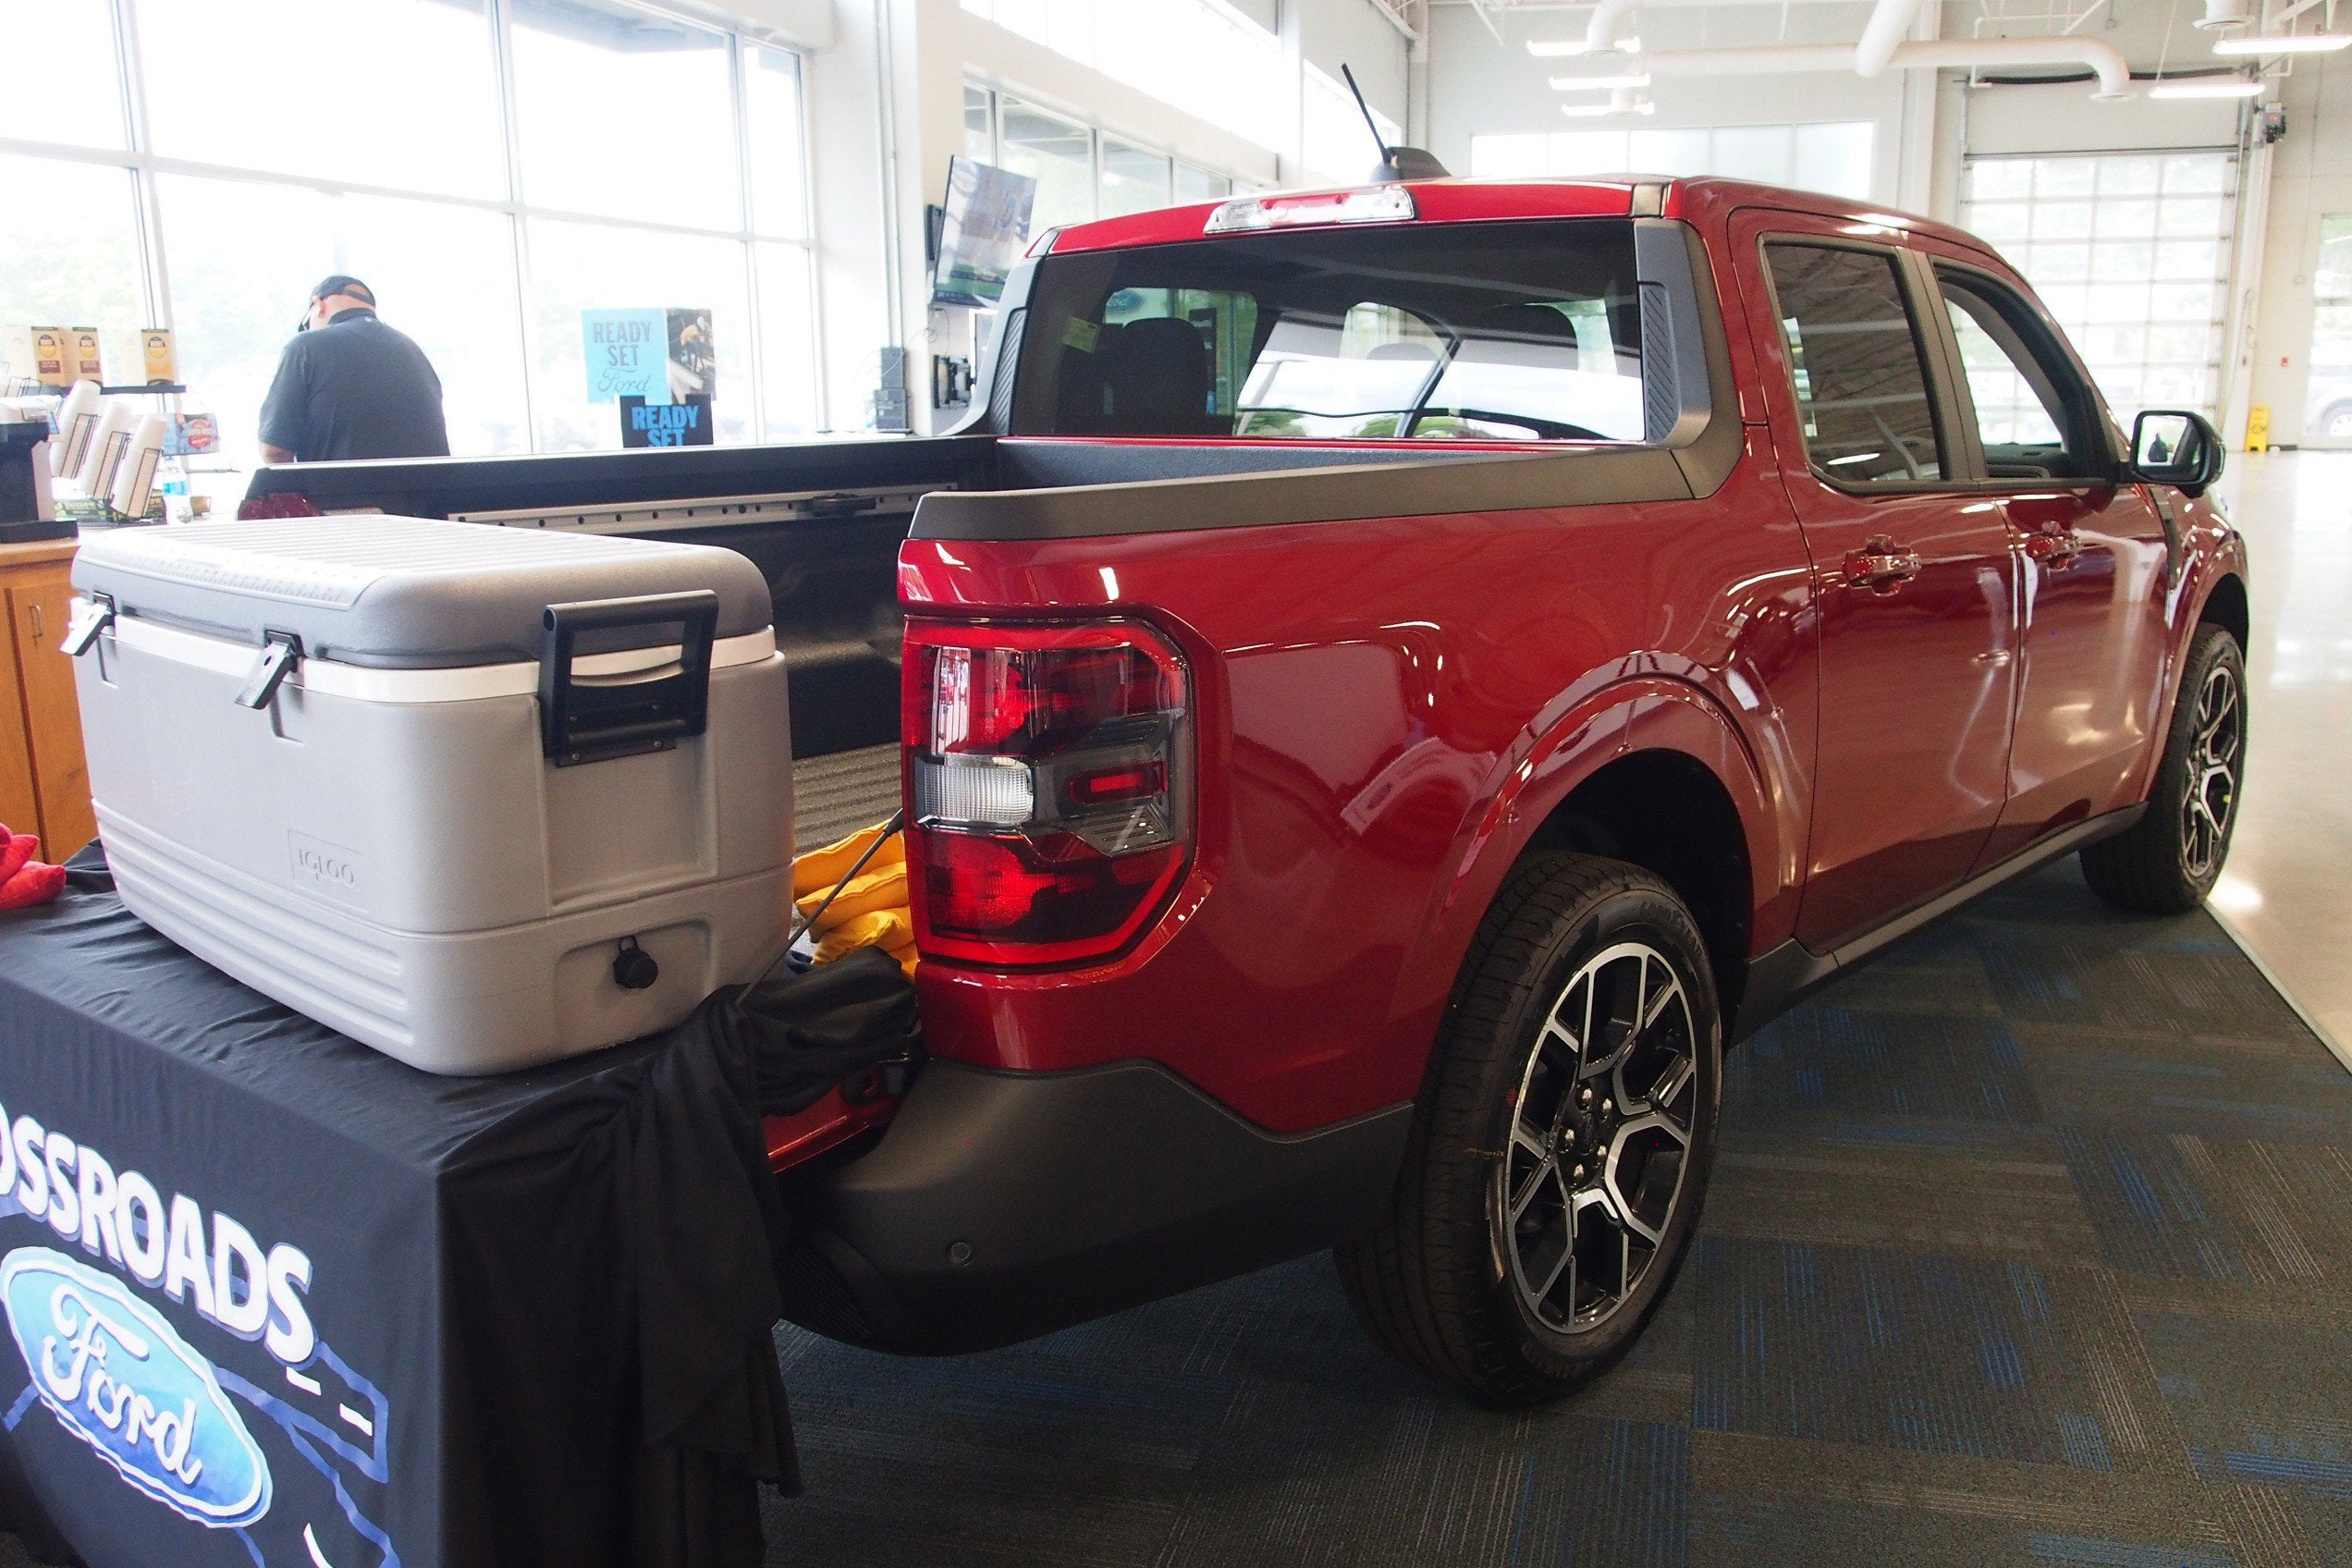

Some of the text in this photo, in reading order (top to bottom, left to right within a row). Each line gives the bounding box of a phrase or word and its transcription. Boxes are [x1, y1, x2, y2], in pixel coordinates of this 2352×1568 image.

[593, 321, 651, 343] READY
[607, 344, 639, 366] SET
[598, 368, 651, 392] Ford
[631, 405, 699, 430] READY
[42, 1284, 202, 1485] Ford
